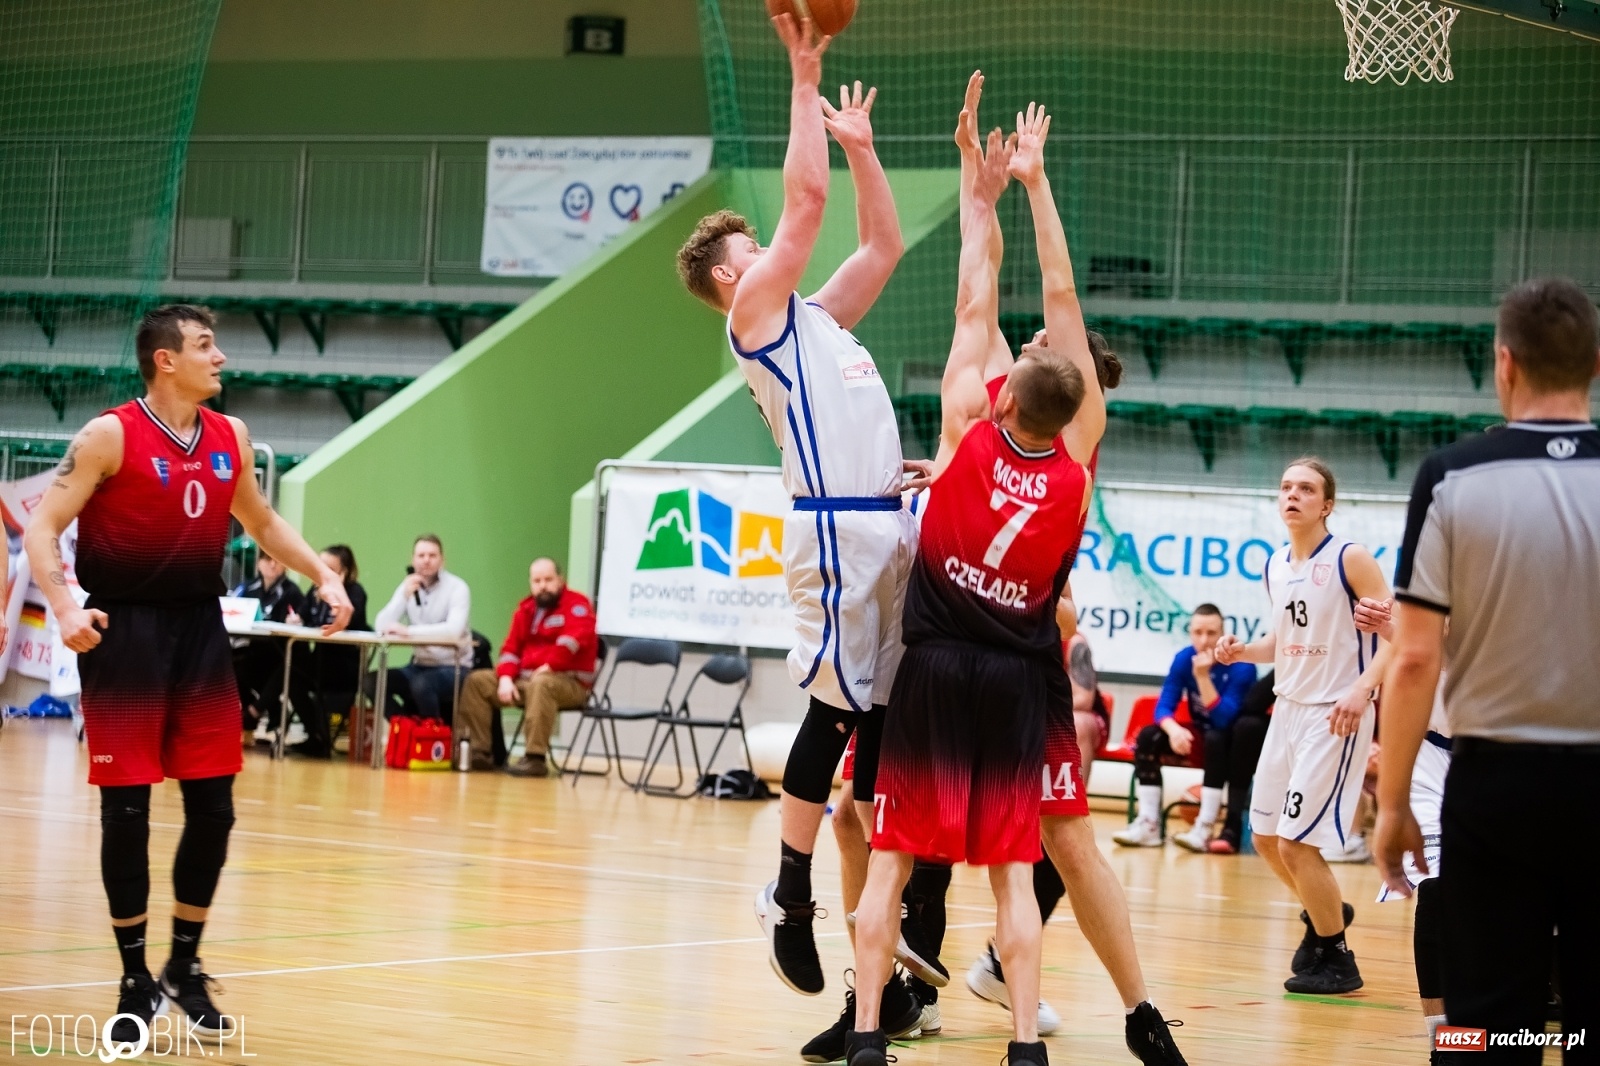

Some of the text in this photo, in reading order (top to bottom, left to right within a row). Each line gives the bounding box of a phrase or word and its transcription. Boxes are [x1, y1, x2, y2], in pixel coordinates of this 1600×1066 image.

[584, 28, 613, 50] B
[993, 456, 1048, 500] MCKS
[183, 479, 207, 519] 0
[982, 487, 1039, 570] 7
[629, 581, 797, 609] powiat racibors
[944, 555, 1029, 609] CZELADŹ
[1285, 600, 1308, 628] 13
[1041, 762, 1077, 801] 14
[874, 793, 887, 834] 7
[1283, 790, 1304, 819] 13
